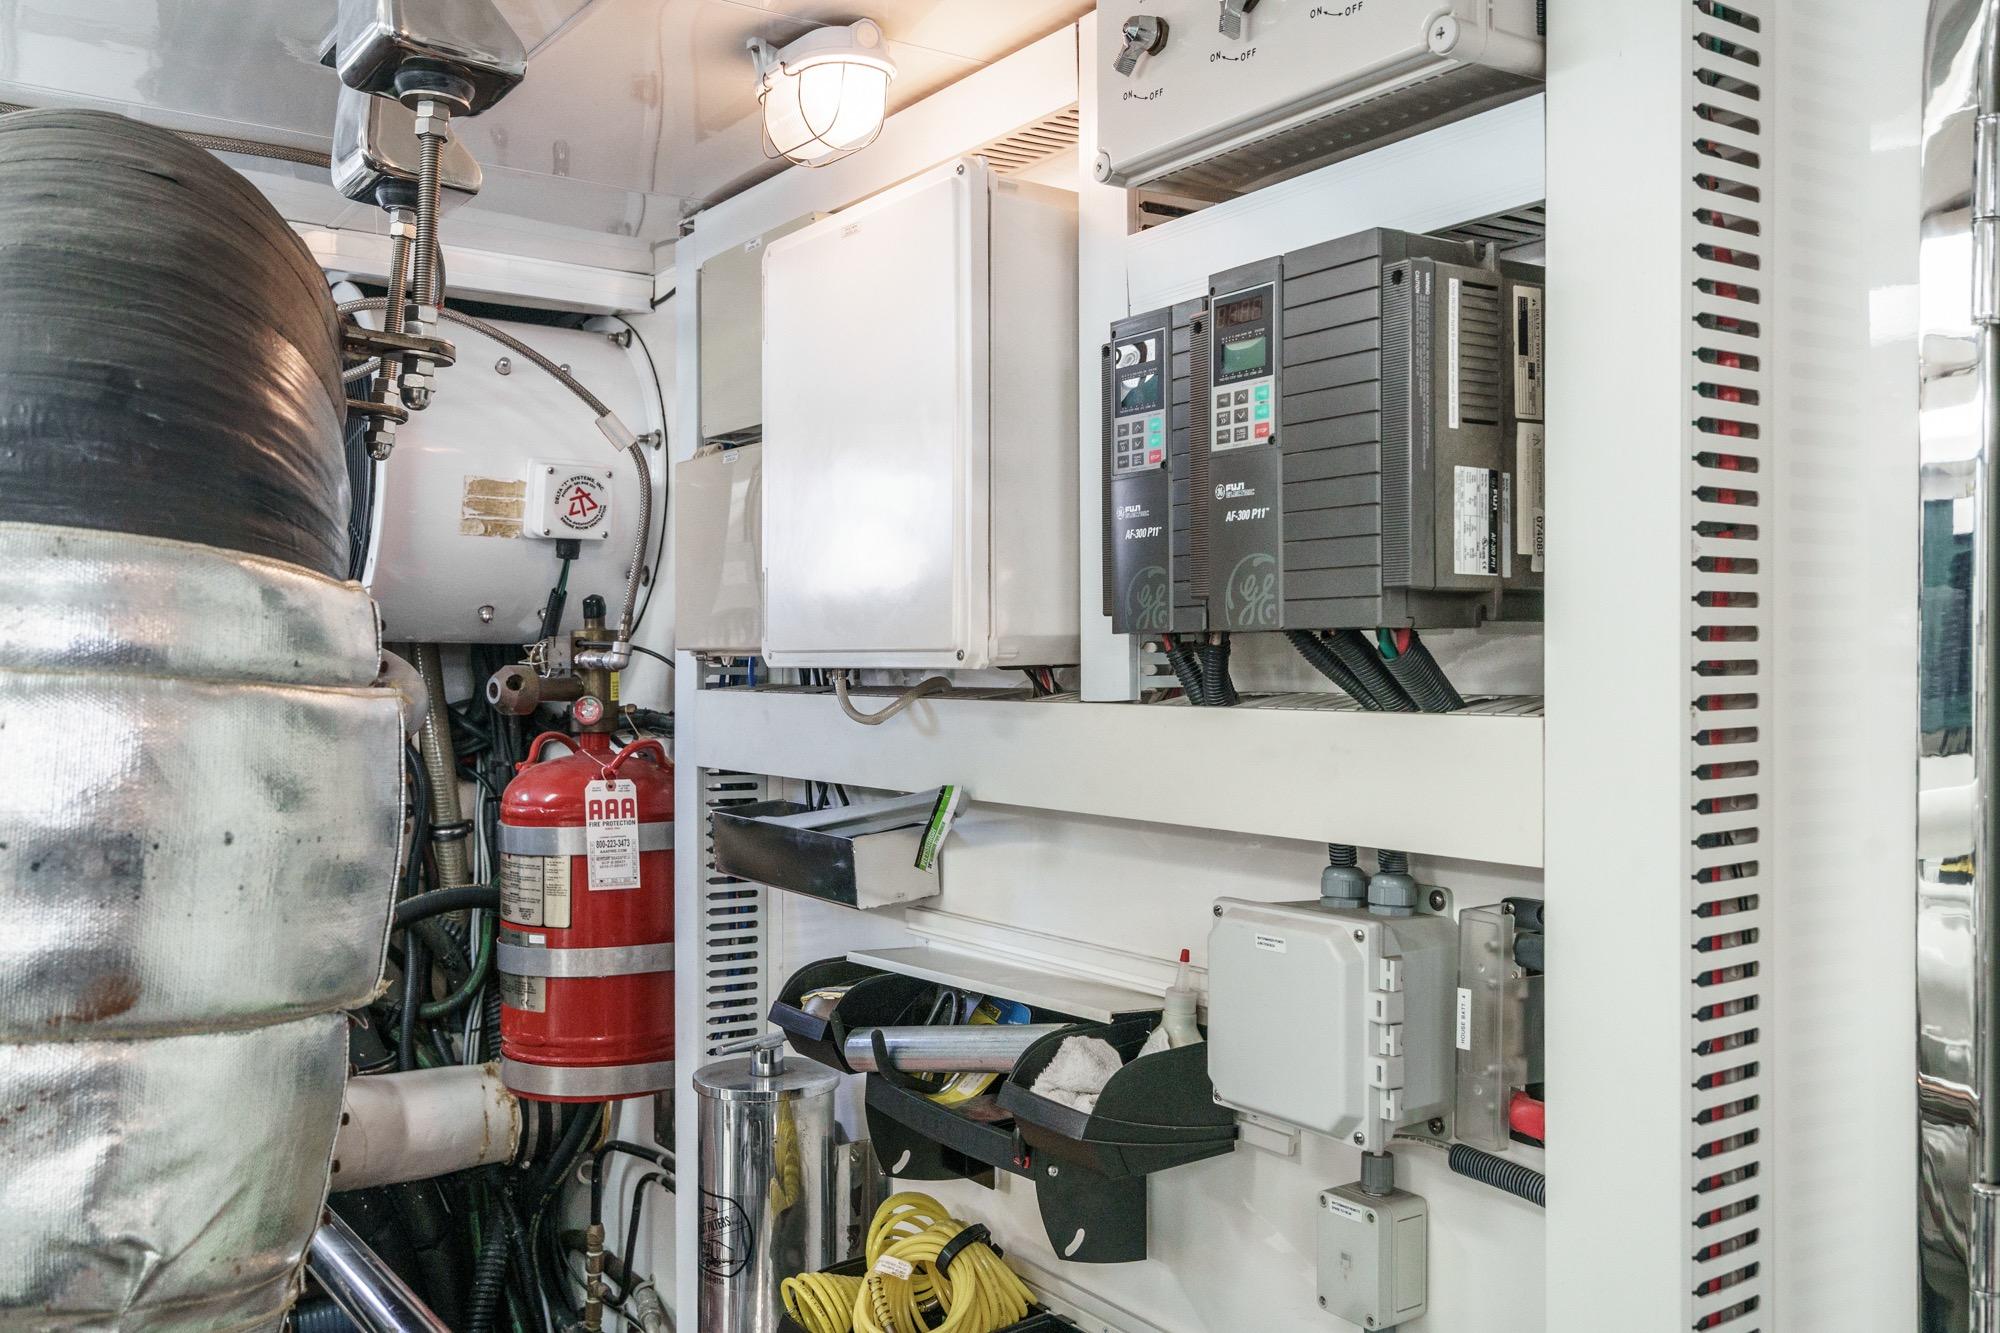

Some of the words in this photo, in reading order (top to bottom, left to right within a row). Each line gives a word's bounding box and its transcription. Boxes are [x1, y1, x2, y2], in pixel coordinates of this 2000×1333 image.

[1310, 6, 1323, 19] ON
[1345, 2, 1363, 17] OFF
[1210, 51, 1221, 62] ON
[1240, 48, 1257, 62] OFF
[1123, 90, 1133, 100] ON
[1149, 87, 1164, 100] OFF
[555, 488, 563, 504] DELTA
[1225, 509, 1251, 522] AF-300
[1125, 527, 1148, 540] AF-300
[589, 798, 635, 820] AAA
[595, 838, 631, 849] 800-223-3473
